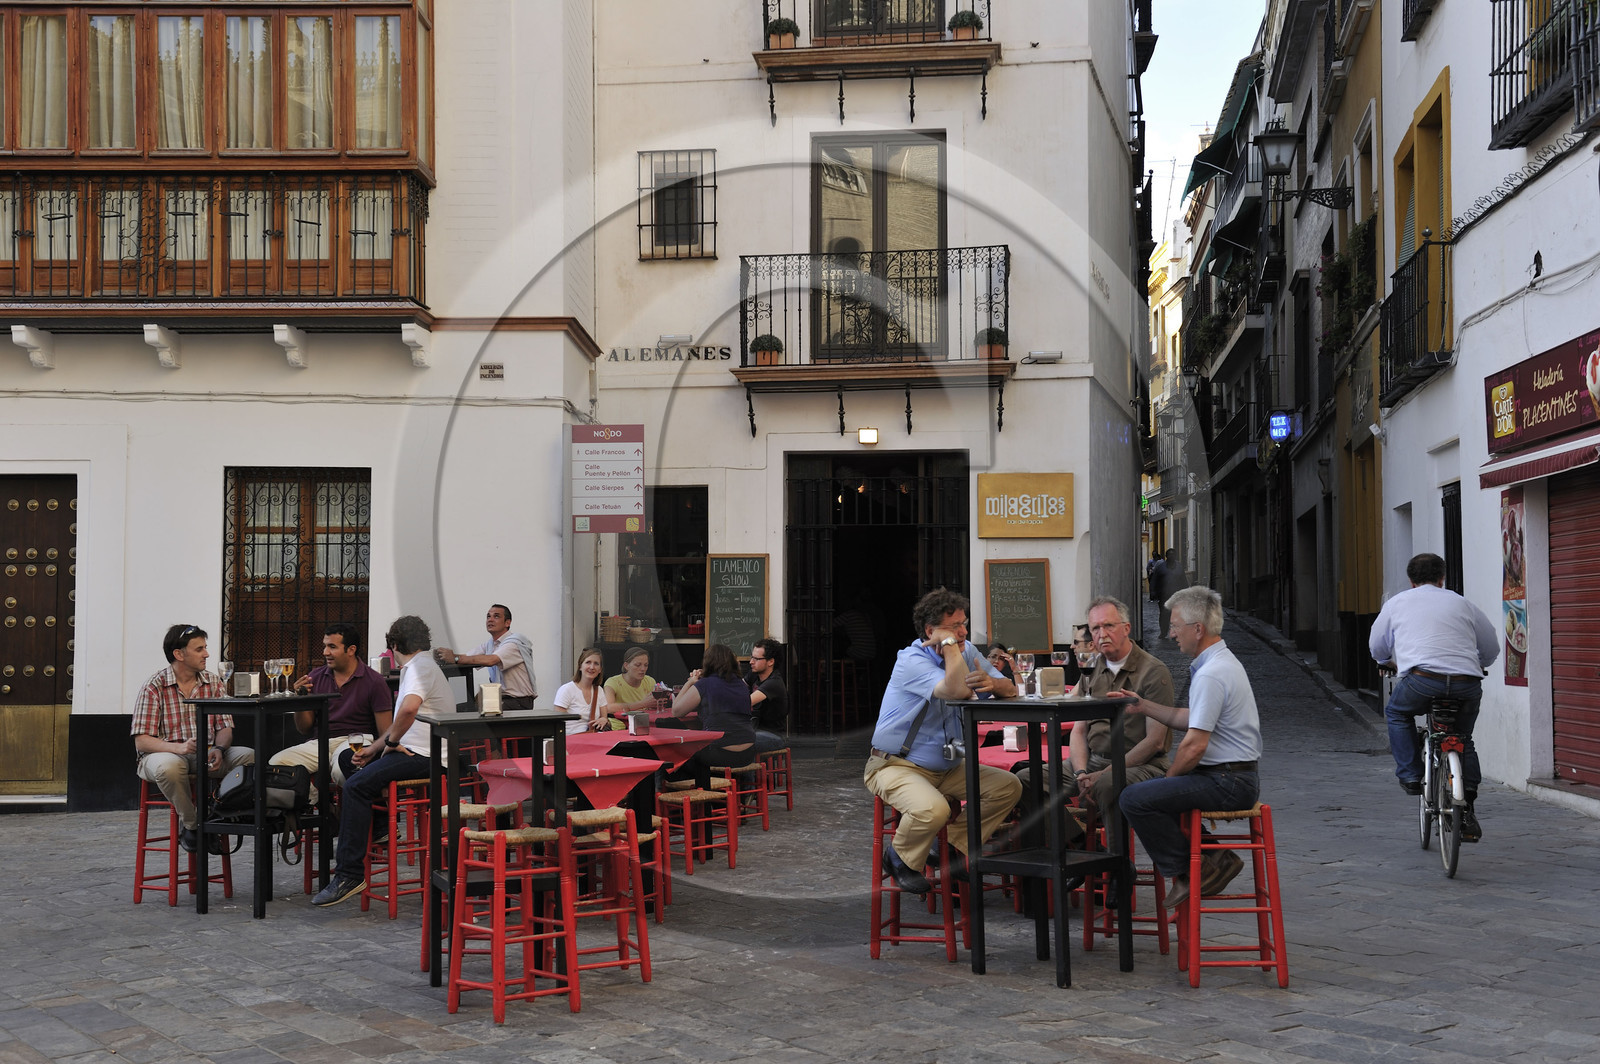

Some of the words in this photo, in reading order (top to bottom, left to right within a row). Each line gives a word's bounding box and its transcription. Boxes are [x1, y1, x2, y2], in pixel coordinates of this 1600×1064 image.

[608, 346, 731, 362] ALEMANES
[1533, 364, 1564, 391] Heladería
[1494, 396, 1514, 417] CARTE
[1523, 390, 1578, 429] PLACENTINES
[1272, 417, 1286, 426] TEX
[1497, 415, 1513, 433] D'OR
[1273, 428, 1286, 436] MEX
[713, 560, 760, 573] FLAMENCO
[722, 575, 749, 586] SHOW
